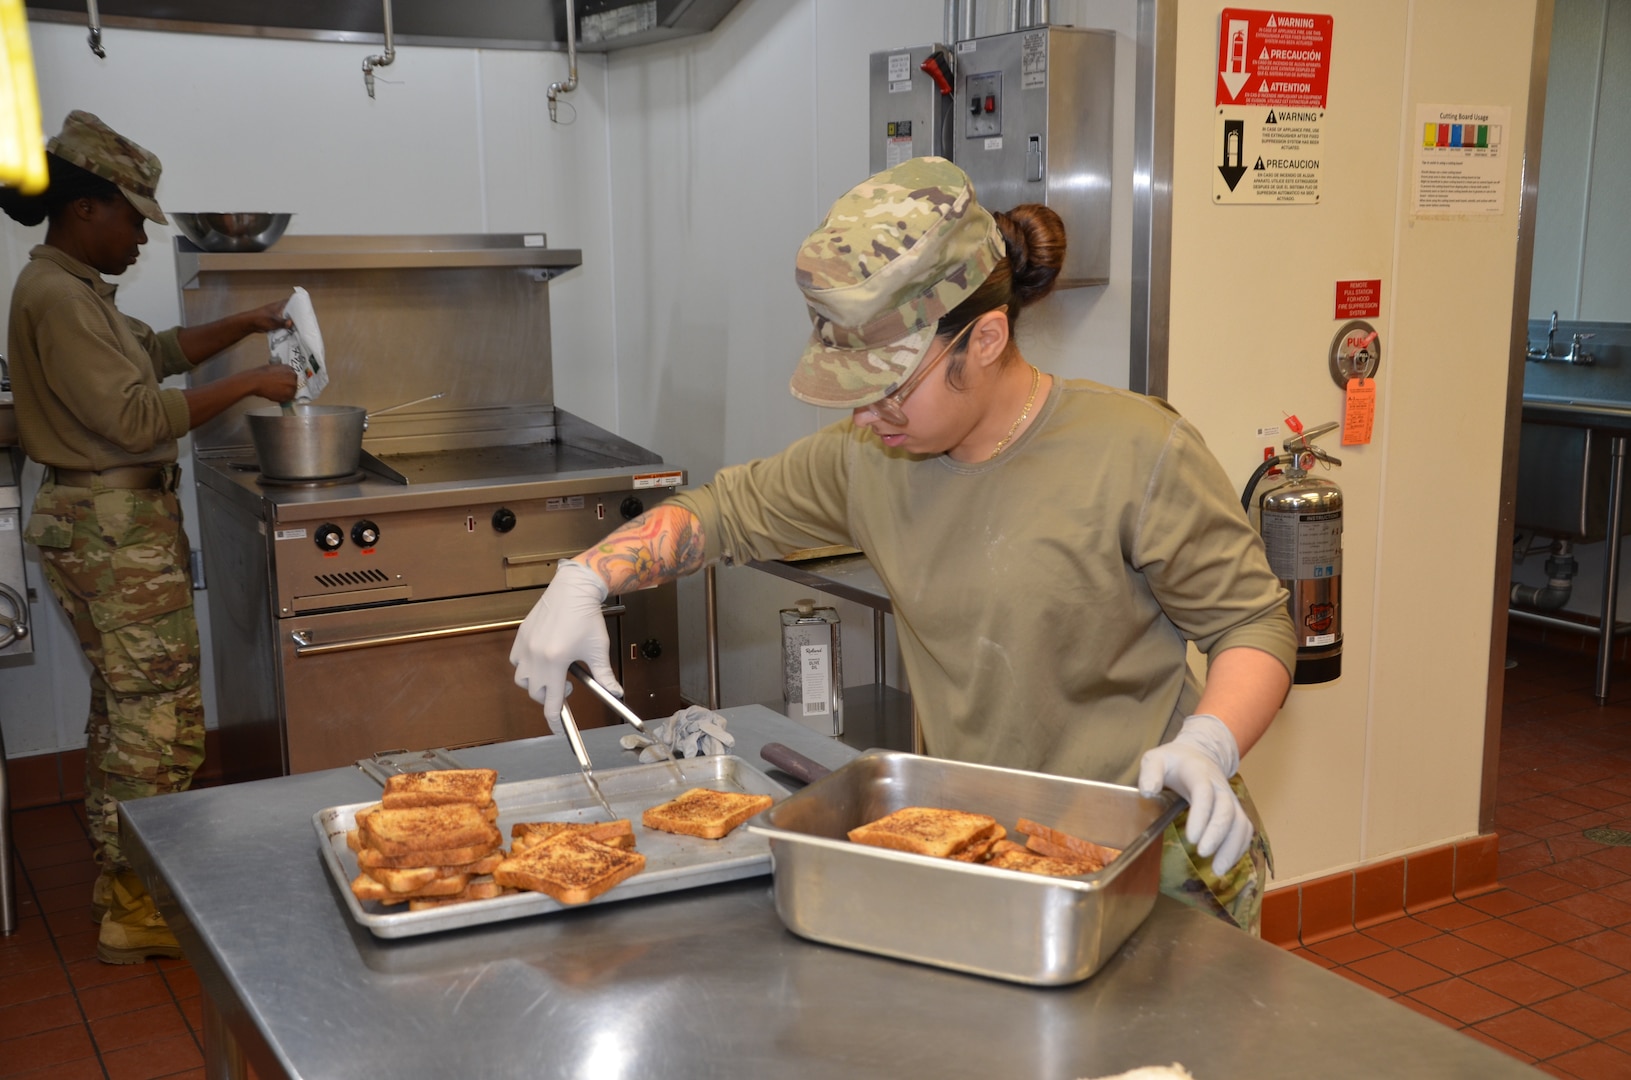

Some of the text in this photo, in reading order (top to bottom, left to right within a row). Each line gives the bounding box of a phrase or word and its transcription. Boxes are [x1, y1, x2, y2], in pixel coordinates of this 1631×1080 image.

[1277, 16, 1314, 28] WARNING
[1270, 49, 1321, 61] PRECAUCIÓN
[1270, 82, 1310, 93] ATTENTION
[1279, 112, 1317, 122] WARNING
[1440, 112, 1458, 120] Cutting
[1267, 159, 1319, 169] PRECAUCION
[1348, 337, 1366, 347] PUL
